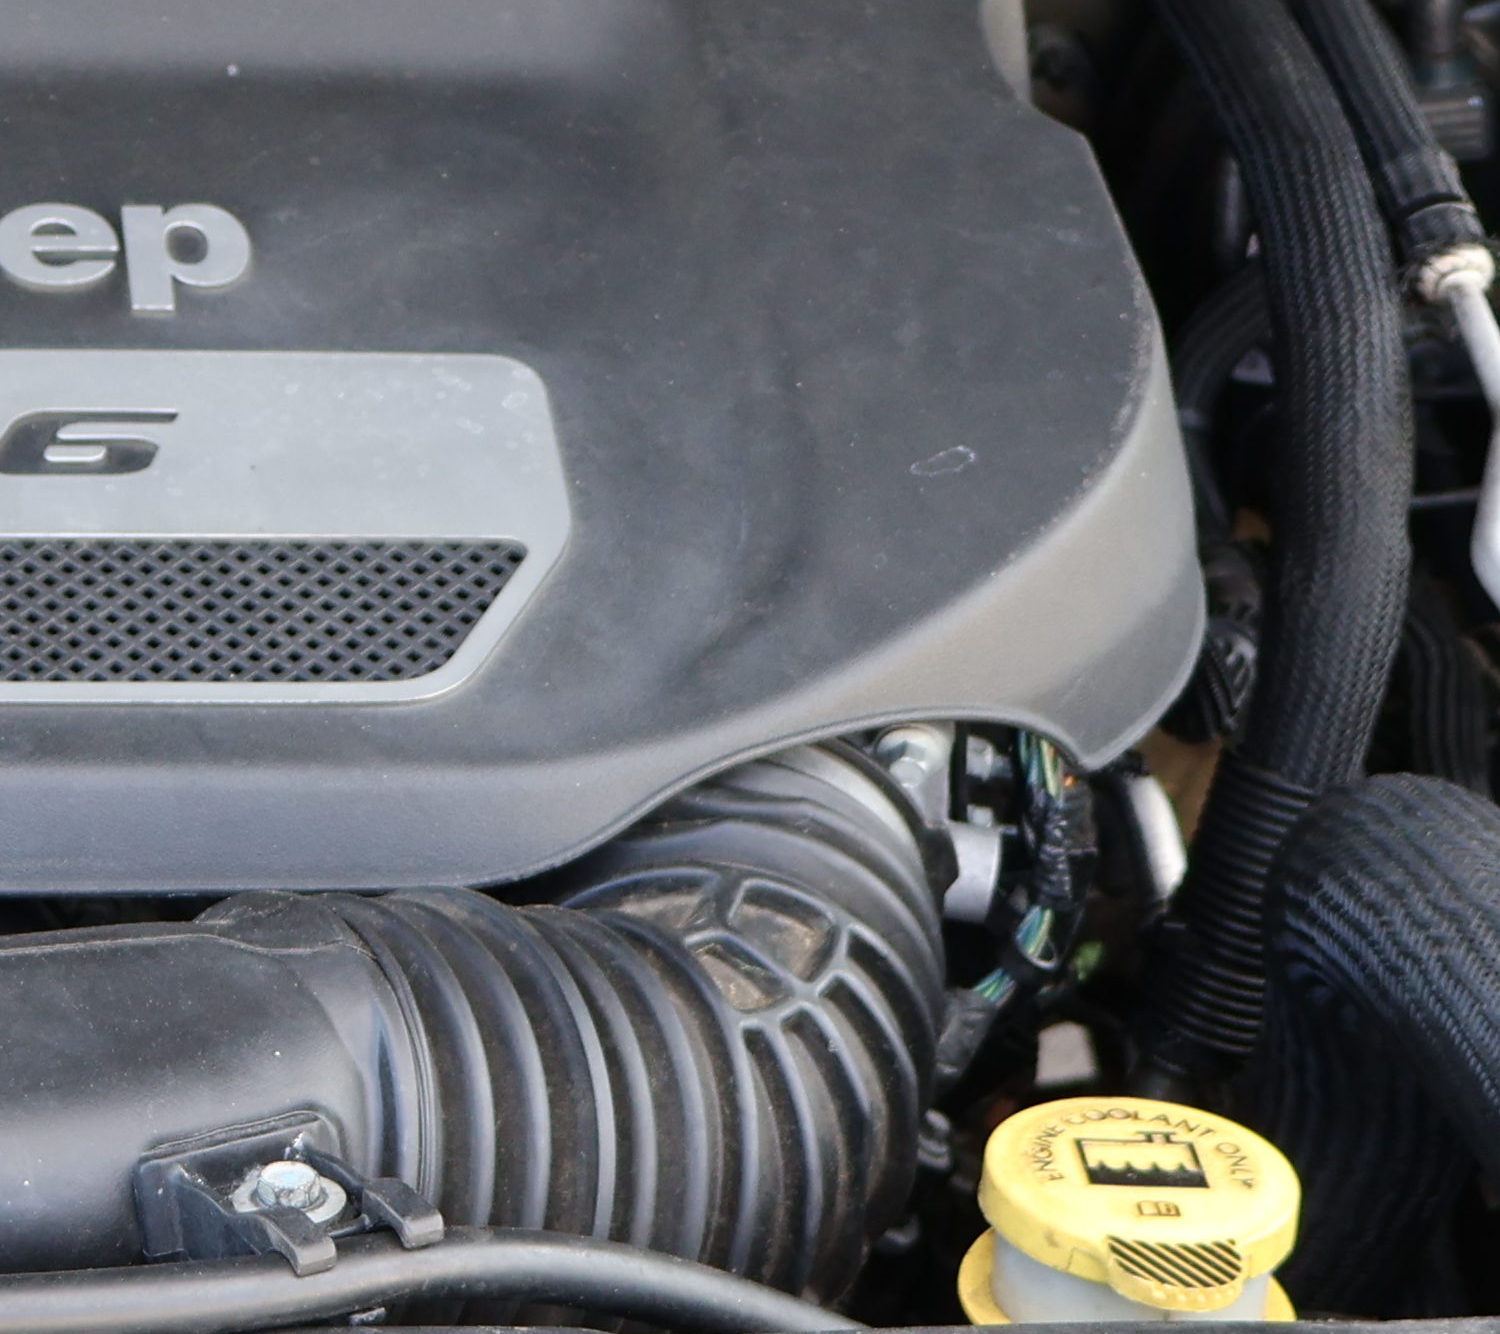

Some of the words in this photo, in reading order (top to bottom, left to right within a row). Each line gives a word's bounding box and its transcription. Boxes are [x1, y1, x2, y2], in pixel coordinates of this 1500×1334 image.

[1030, 1125, 1066, 1183] ENGINE
[1064, 1107, 1216, 1138] COOLANT
[1215, 1141, 1257, 1190] ONLY
